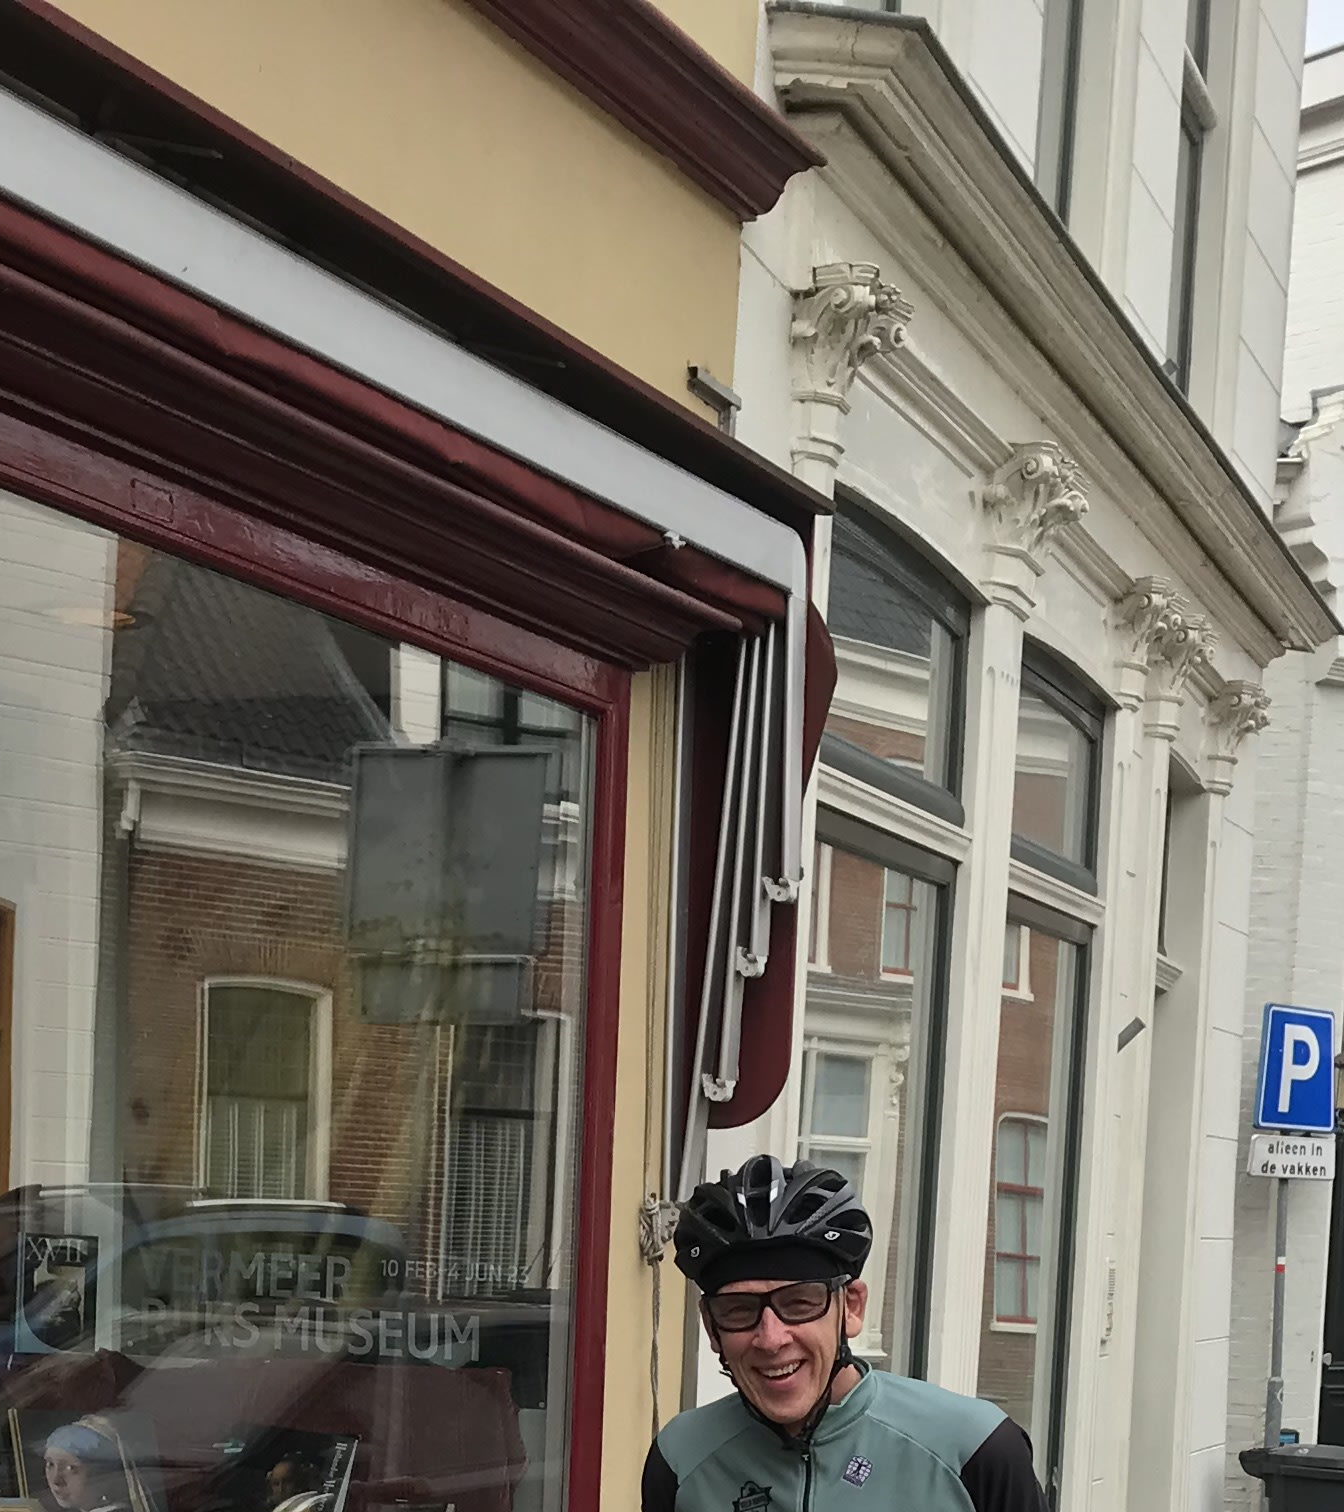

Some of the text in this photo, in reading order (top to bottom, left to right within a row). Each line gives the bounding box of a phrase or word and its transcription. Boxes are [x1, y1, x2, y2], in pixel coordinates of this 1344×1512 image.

[1277, 1022, 1321, 1113] P
[1267, 1141, 1324, 1157] alleen in
[1260, 1159, 1327, 1177] de vakken
[380, 1259, 399, 1278] 10
[405, 1260, 438, 1280] FEB
[465, 1264, 502, 1283] JUN
[273, 1305, 481, 1363] MUSEUM
